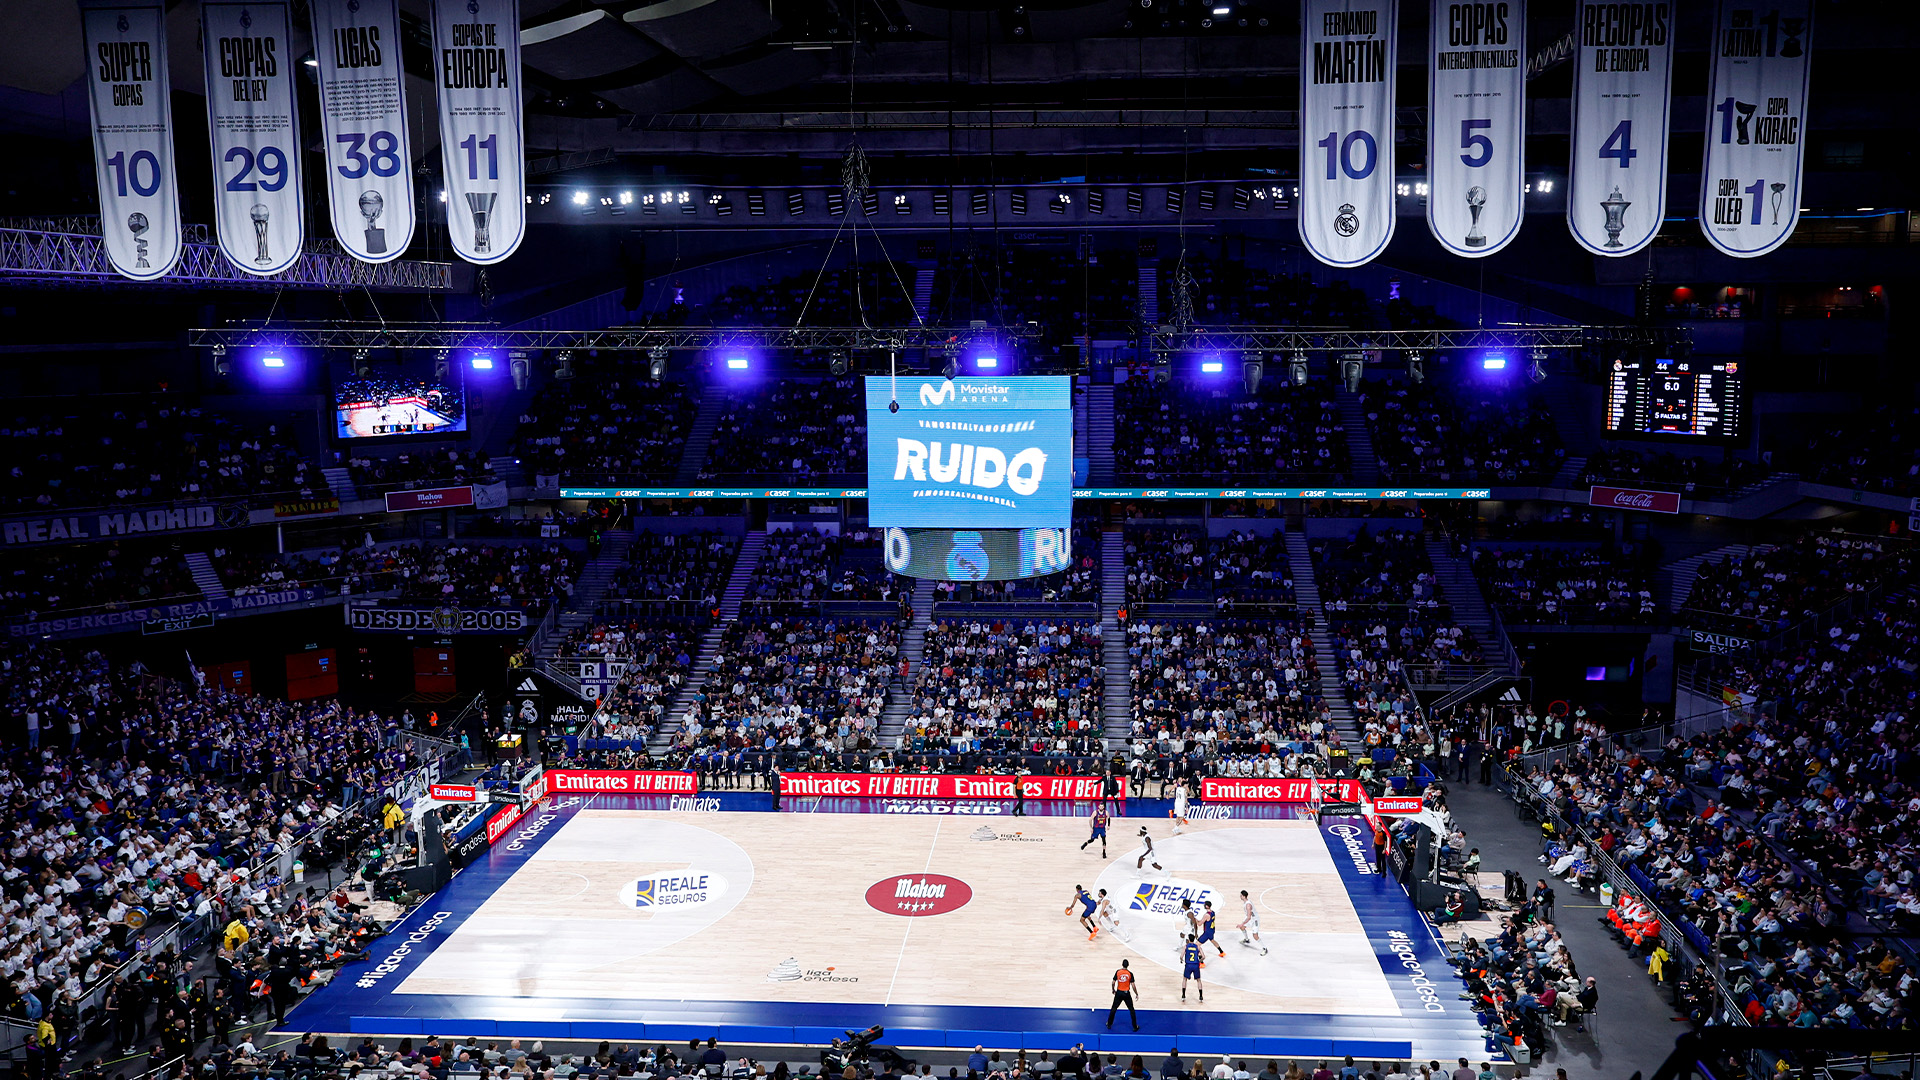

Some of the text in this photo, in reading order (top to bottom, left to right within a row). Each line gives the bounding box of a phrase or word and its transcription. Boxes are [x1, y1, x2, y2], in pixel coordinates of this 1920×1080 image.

[1323, 10, 1377, 36] FERNANDO
[1449, 3, 1508, 46] COPAS
[1583, 3, 1667, 47] RECOPAS
[452, 23, 496, 47] COPAS DE
[1721, 28, 1761, 57] LATINA
[219, 37, 277, 77] COPAS
[333, 25, 382, 68] LIGAS
[97, 41, 152, 82] SUPER
[443, 48, 508, 89] EUROPA
[1313, 35, 1385, 84] MARTÍN
[1438, 50, 1518, 70] INTERCONTINENTALES
[1596, 48, 1650, 73] DE EUROPA
[113, 84, 143, 106] COPAS
[232, 79, 267, 102] DEL REY
[1767, 98, 1788, 115] COPA
[1717, 97, 1735, 144] 1
[1755, 117, 1797, 145] KORAC
[1460, 118, 1493, 168] 5
[1598, 120, 1637, 168] 4
[336, 130, 401, 179] 38
[460, 134, 498, 180] 11
[1318, 130, 1378, 180] 10
[107, 150, 161, 197] 10
[224, 146, 288, 192] 29
[1718, 179, 1738, 196] COPA
[1714, 197, 1742, 225] ULEB
[1745, 179, 1764, 225] 1
[1678, 363, 1689, 371] 48
[960, 384, 1009, 394] Movistar
[1664, 381, 1680, 391] 6.0
[961, 395, 1008, 403] ARENA
[918, 419, 1035, 433] VAMOSREALVAMOSREAL
[1654, 411, 1660, 419] 5
[1681, 413, 1687, 421] 5
[893, 437, 1048, 496] RUIDO
[417, 493, 442, 501] Mahou
[913, 489, 1016, 508] VAMOSREALVAMOSREAL
[3, 506, 215, 544] REAL MADRID
[9, 609, 147, 637] BERSERKERS
[167, 601, 219, 615] REAL
[230, 591, 299, 609] MADRID
[164, 620, 191, 630] EXIT
[352, 609, 522, 630] DESDE 2005
[585, 665, 622, 676] R M
[586, 688, 595, 698] C
[556, 706, 584, 715] ¡HALA
[433, 787, 473, 798] Emirates
[554, 773, 628, 791] Emirates
[634, 774, 652, 791] FLY
[654, 774, 693, 791] BETTER
[780, 776, 1073, 797] Emirates FLY BETTER Emiraes FLY
[1205, 783, 1308, 799] Emirates FLY
[669, 794, 721, 813] Emirates
[886, 805, 1002, 814] MADRID
[1186, 802, 1232, 819] mirates
[1377, 800, 1419, 810] Emirates
[505, 813, 557, 851] endesa
[459, 830, 487, 857] endesa
[659, 875, 708, 892] REALE
[894, 878, 947, 898] Mahou
[1157, 885, 1211, 904] REALE
[658, 892, 707, 905] SEGUROS
[355, 911, 453, 988] #ligaendesa
[1189, 953, 1195, 961] 2
[803, 975, 858, 983] endesa
[1386, 930, 1446, 1013] #ligaendesa
